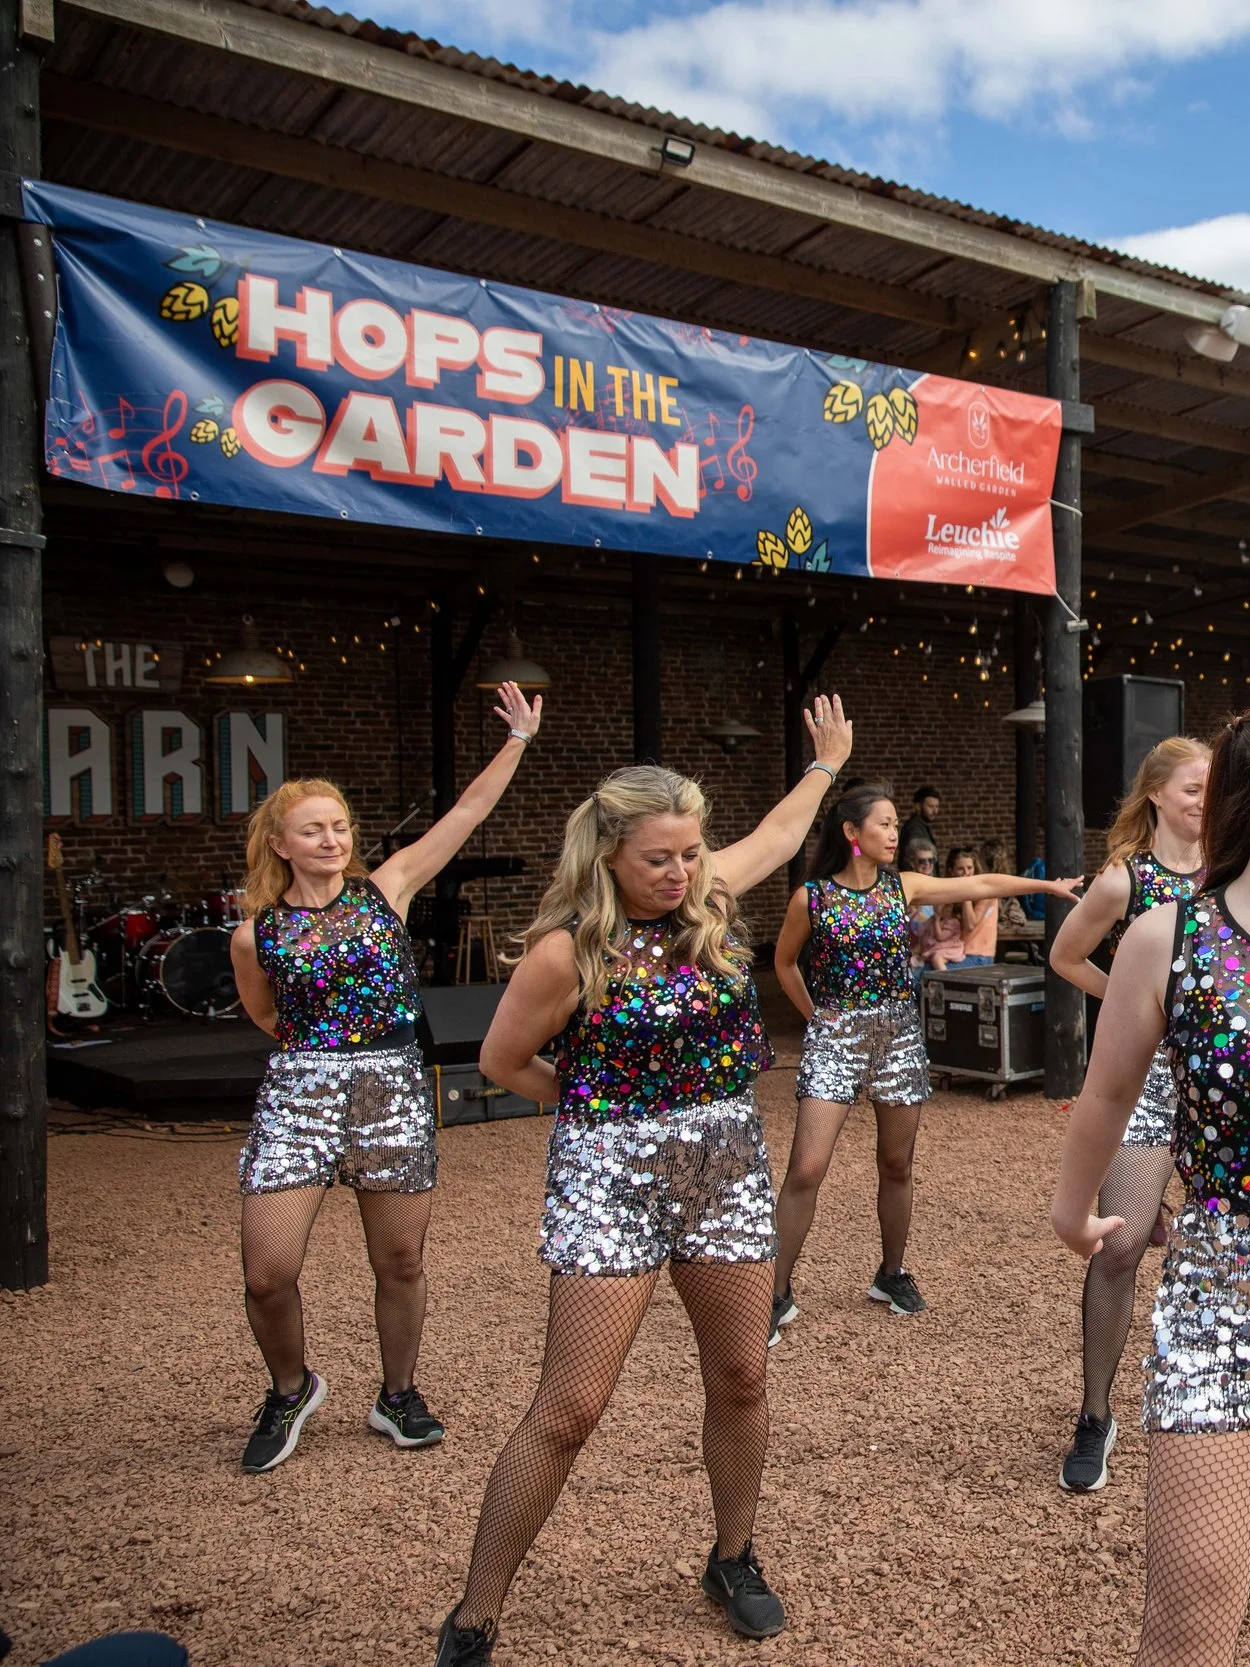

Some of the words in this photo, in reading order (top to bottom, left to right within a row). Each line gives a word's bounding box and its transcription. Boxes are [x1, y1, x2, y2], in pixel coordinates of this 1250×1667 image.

[236, 273, 546, 405] HOPS
[554, 355, 595, 413] IN
[606, 365, 681, 427] THE
[232, 378, 700, 519] GARDEN
[927, 446, 1025, 485] Archerfield
[936, 475, 977, 490] WALLED
[979, 482, 1017, 497] GARDEN
[924, 512, 1021, 551] Leuchie
[75, 641, 161, 689] THE
[43, 706, 287, 820] ARN
